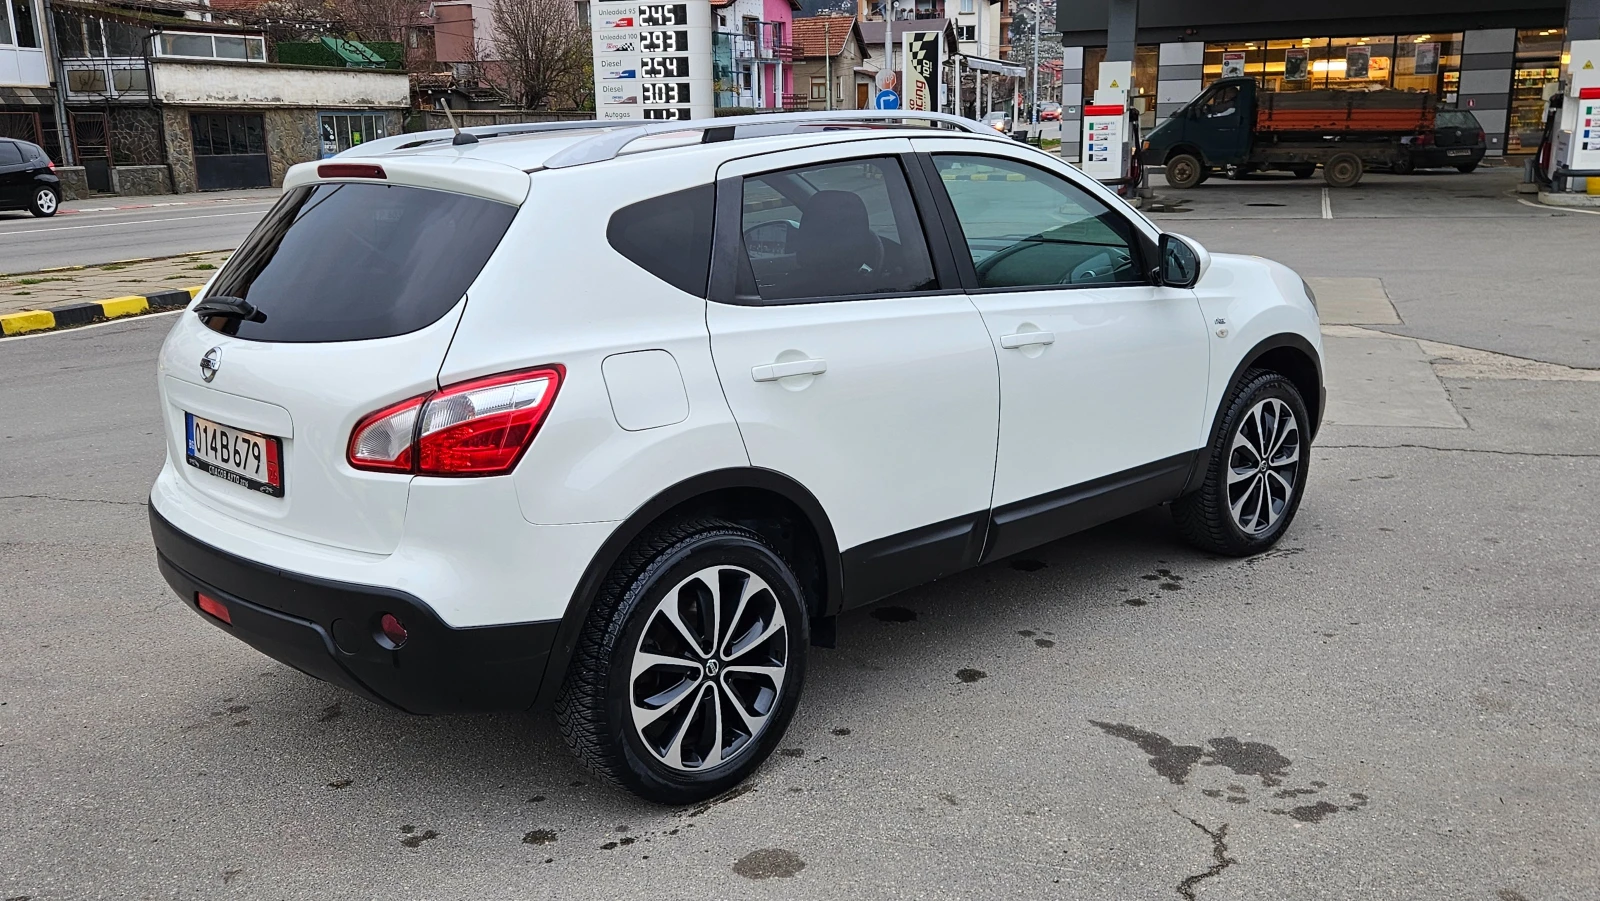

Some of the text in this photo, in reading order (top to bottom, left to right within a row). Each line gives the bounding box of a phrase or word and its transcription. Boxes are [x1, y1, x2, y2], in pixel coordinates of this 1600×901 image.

[598, 8, 627, 16] Unleaded
[640, 4, 675, 26] 2.45
[599, 33, 627, 41] Unleaded
[641, 31, 677, 52] 2.93
[642, 58, 677, 78] 2.54
[922, 60, 930, 78] 100
[602, 85, 624, 93] Diesel
[643, 83, 679, 104] 3.03
[604, 111, 631, 120] Autogas
[195, 422, 261, 474] 014B679
